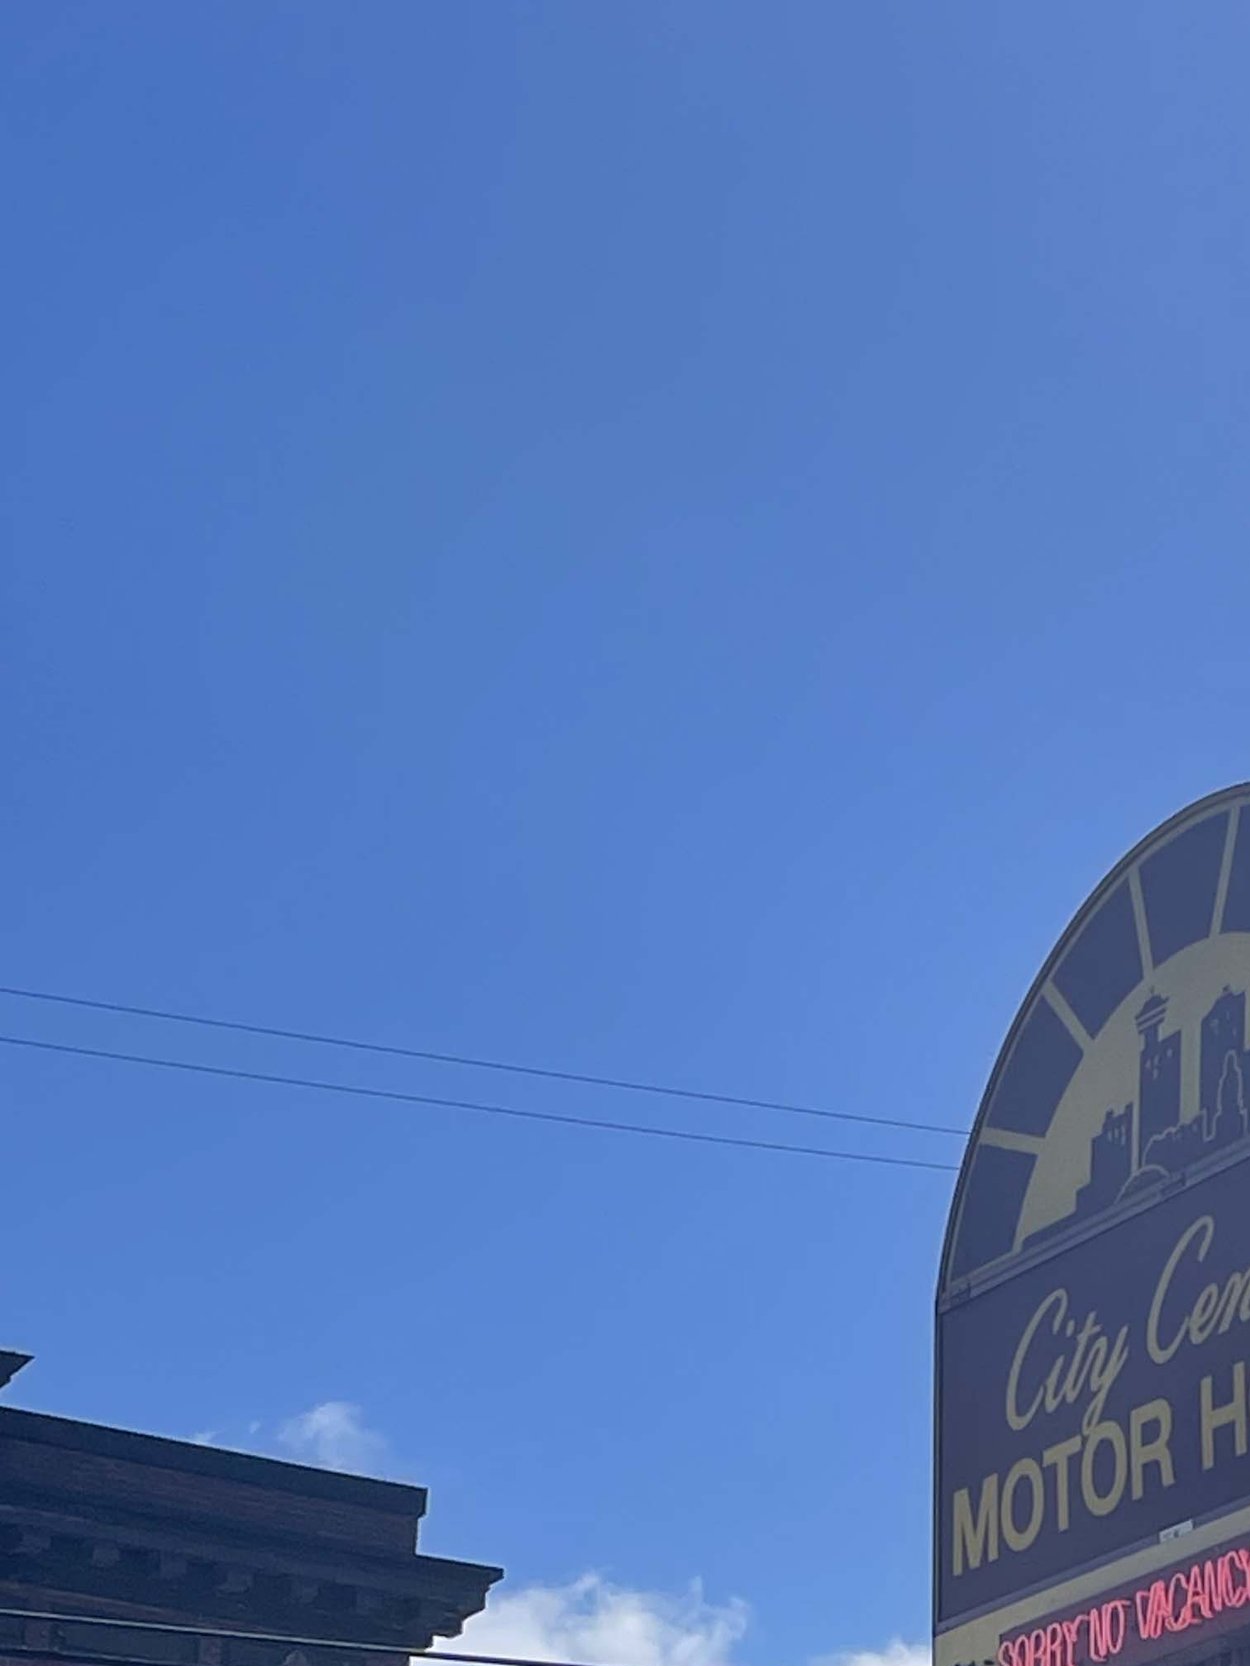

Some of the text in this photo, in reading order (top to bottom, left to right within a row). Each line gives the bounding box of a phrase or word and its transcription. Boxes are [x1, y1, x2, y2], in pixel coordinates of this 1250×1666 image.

[1005, 1287, 1128, 1437] City
[952, 1397, 1176, 1577] MOTOR
[1087, 1599, 1130, 1662] NO
